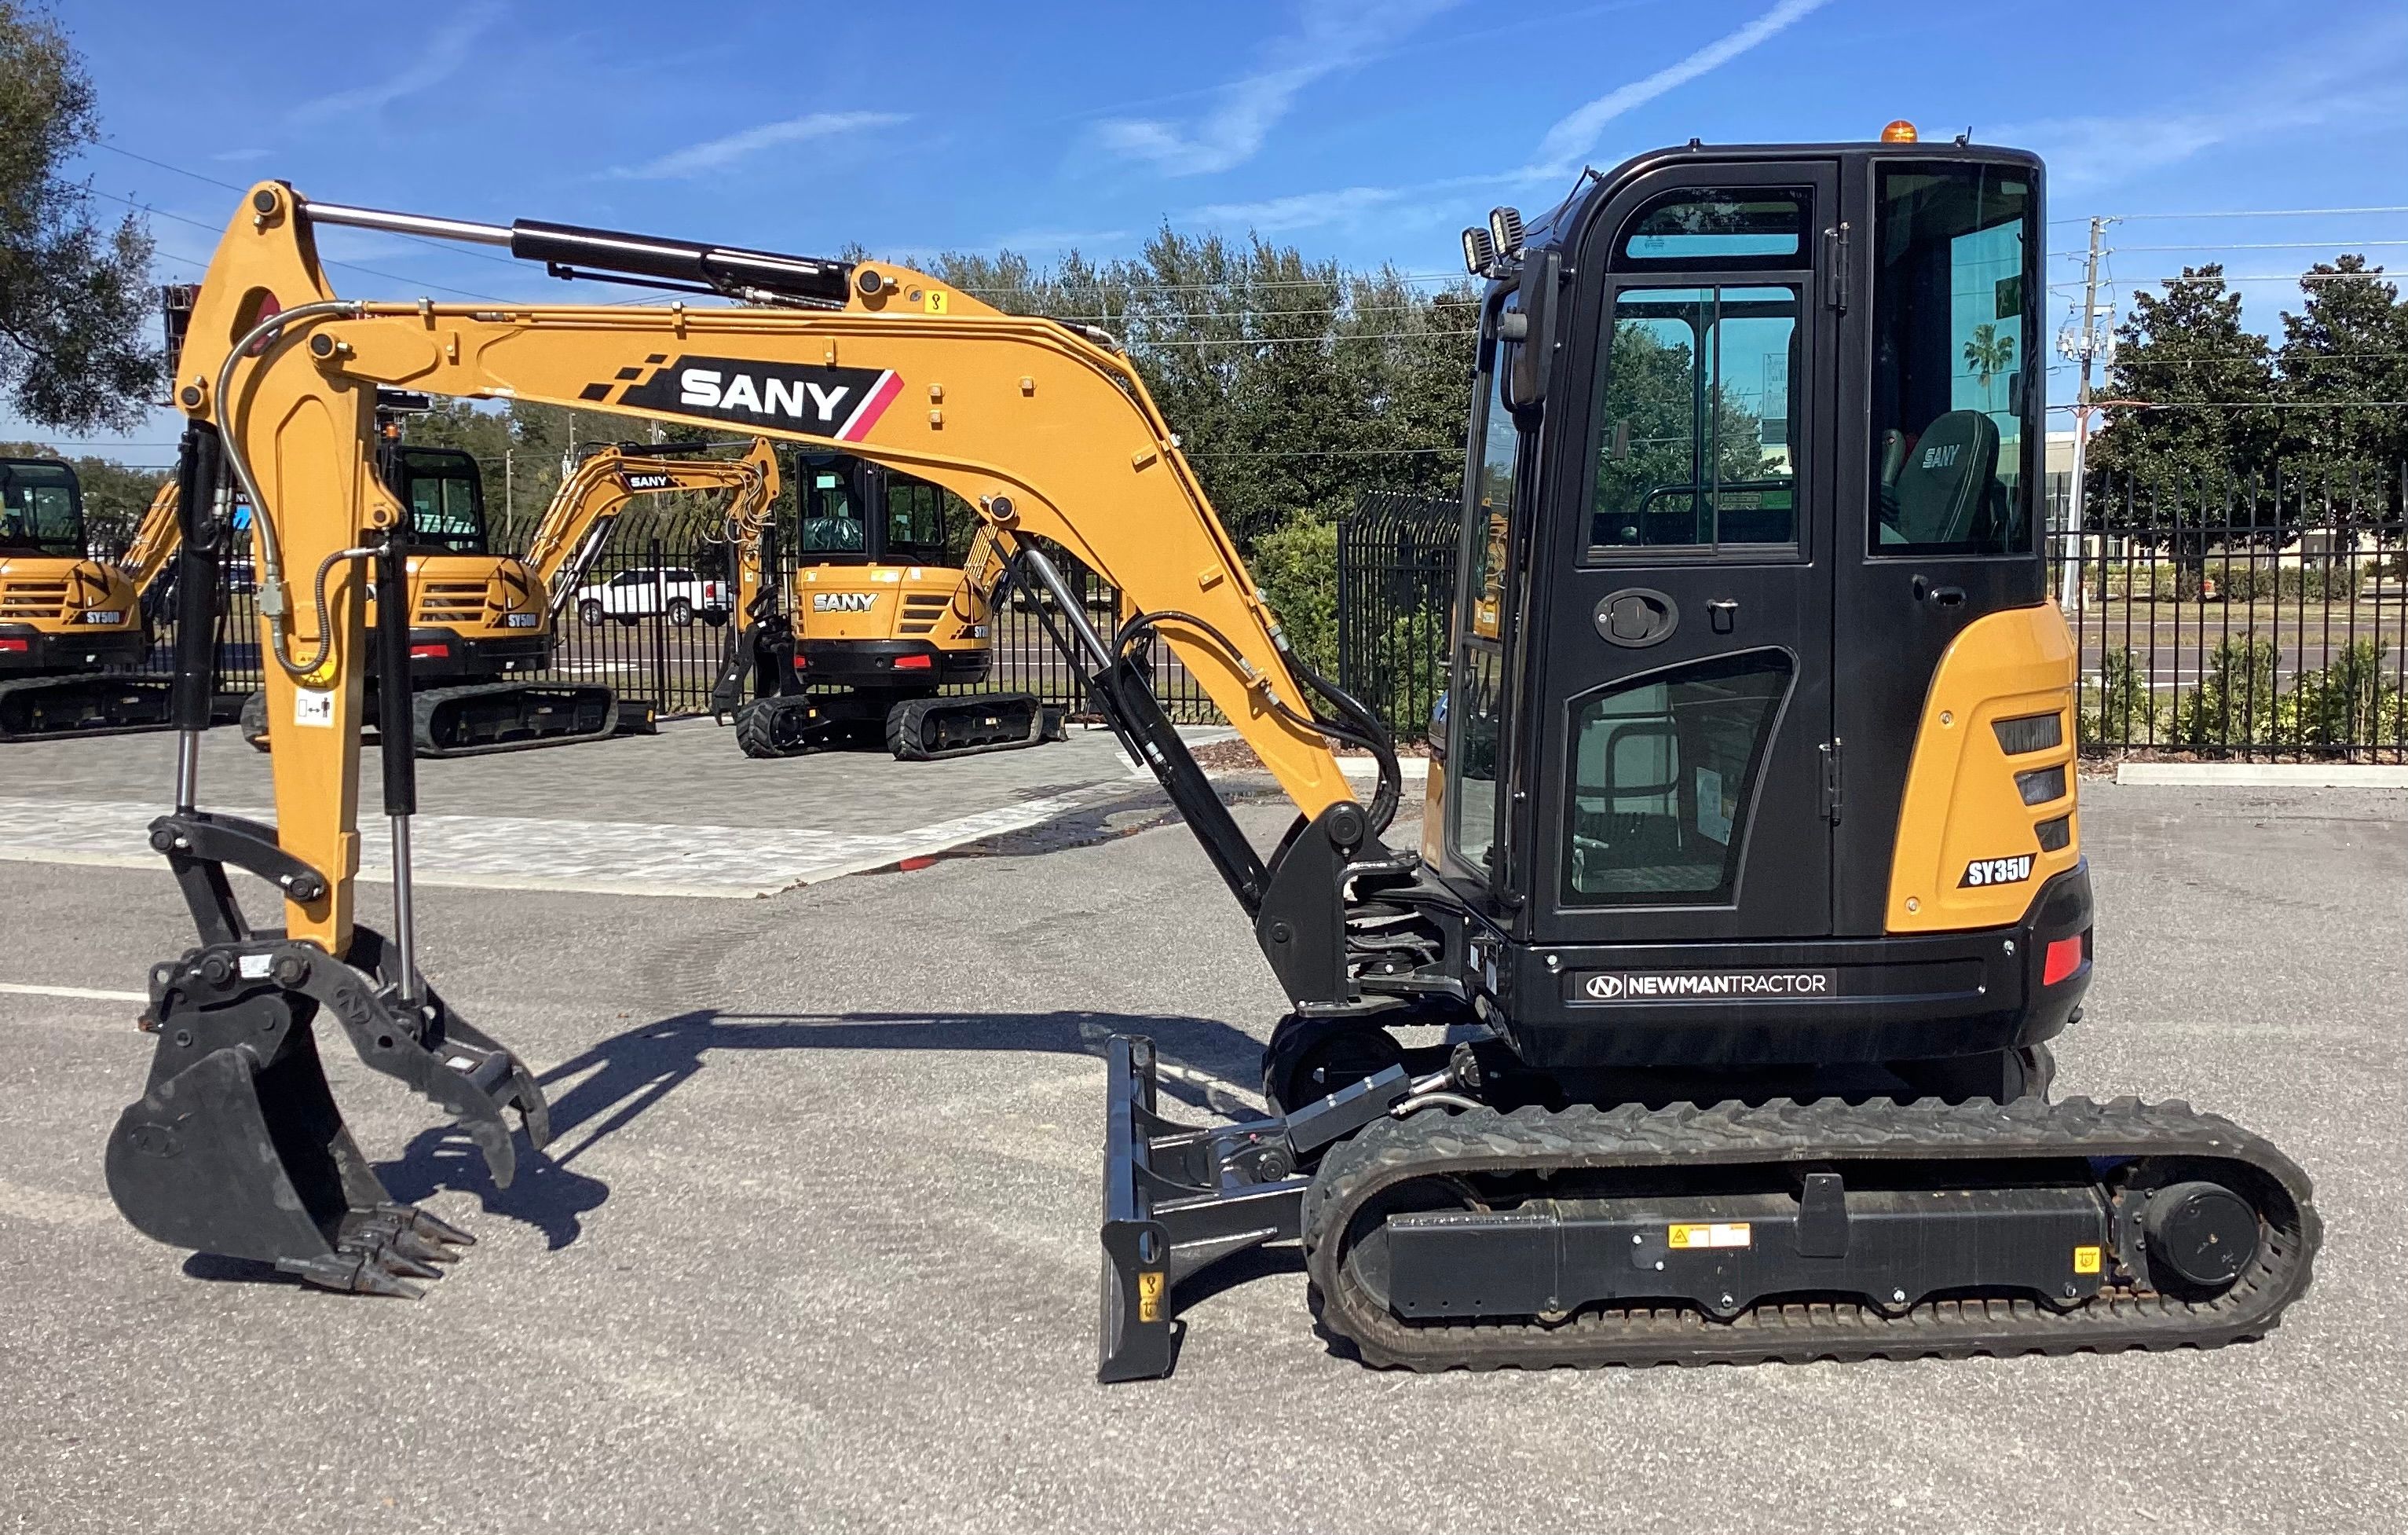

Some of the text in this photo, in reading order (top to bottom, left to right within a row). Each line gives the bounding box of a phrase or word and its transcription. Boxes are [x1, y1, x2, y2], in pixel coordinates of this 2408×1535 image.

[681, 368, 850, 421] SANY
[1922, 444, 1960, 468] SANY
[631, 476, 667, 487] SANY
[813, 593, 879, 612] SANY
[1968, 856, 2029, 885] SY35U
[1629, 974, 1826, 995] NEWMANTRACTOR
